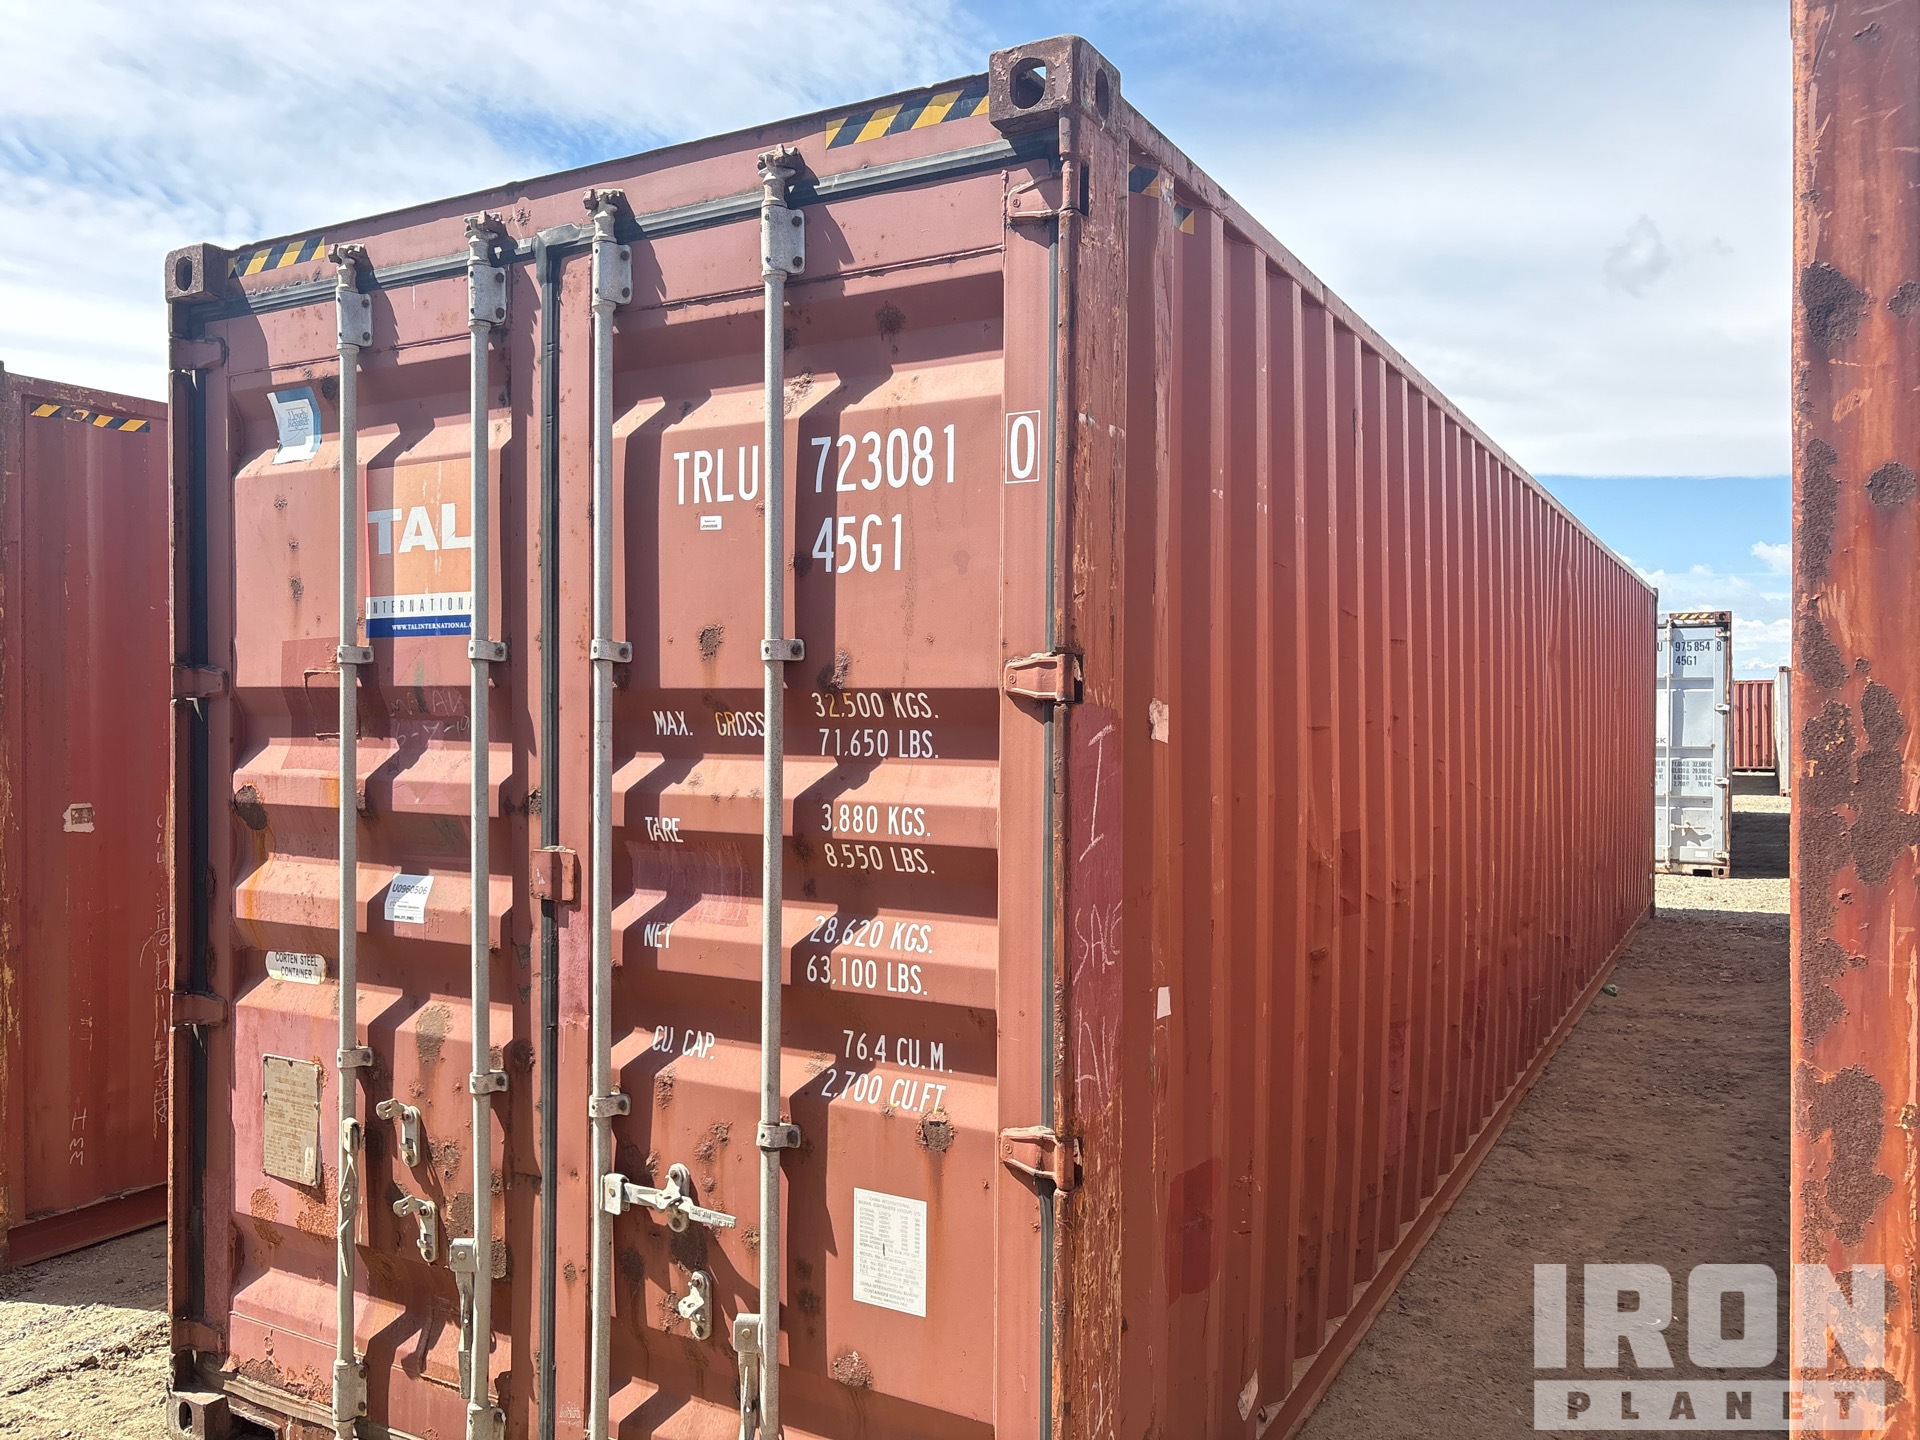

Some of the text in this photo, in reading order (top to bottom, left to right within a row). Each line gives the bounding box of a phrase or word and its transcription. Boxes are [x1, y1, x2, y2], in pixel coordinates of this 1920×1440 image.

[673, 415, 1035, 505] TRLU 723081 0
[367, 502, 472, 555] TAL
[811, 513, 903, 574] 45G1
[1675, 655, 1697, 666] 45G1
[652, 692, 939, 737] MAX. GROSS 32,500 KGS.
[818, 728, 940, 759] 71,650 LBS.
[645, 803, 931, 843] TARE 3,880 KGS.
[823, 843, 936, 875] 8,550 LBS.
[392, 883, 428, 895] U0960506
[643, 914, 934, 955] NET 28,620 KGS.
[275, 952, 318, 967] CORTEN STEEL
[280, 966, 313, 979] CONTAINER
[806, 954, 929, 996] 63,100 LBS.
[652, 1024, 674, 1054] CU.
[681, 1029, 715, 1060] CAP.
[842, 1029, 886, 1063] 76.4
[821, 1068, 882, 1105] 2,700
